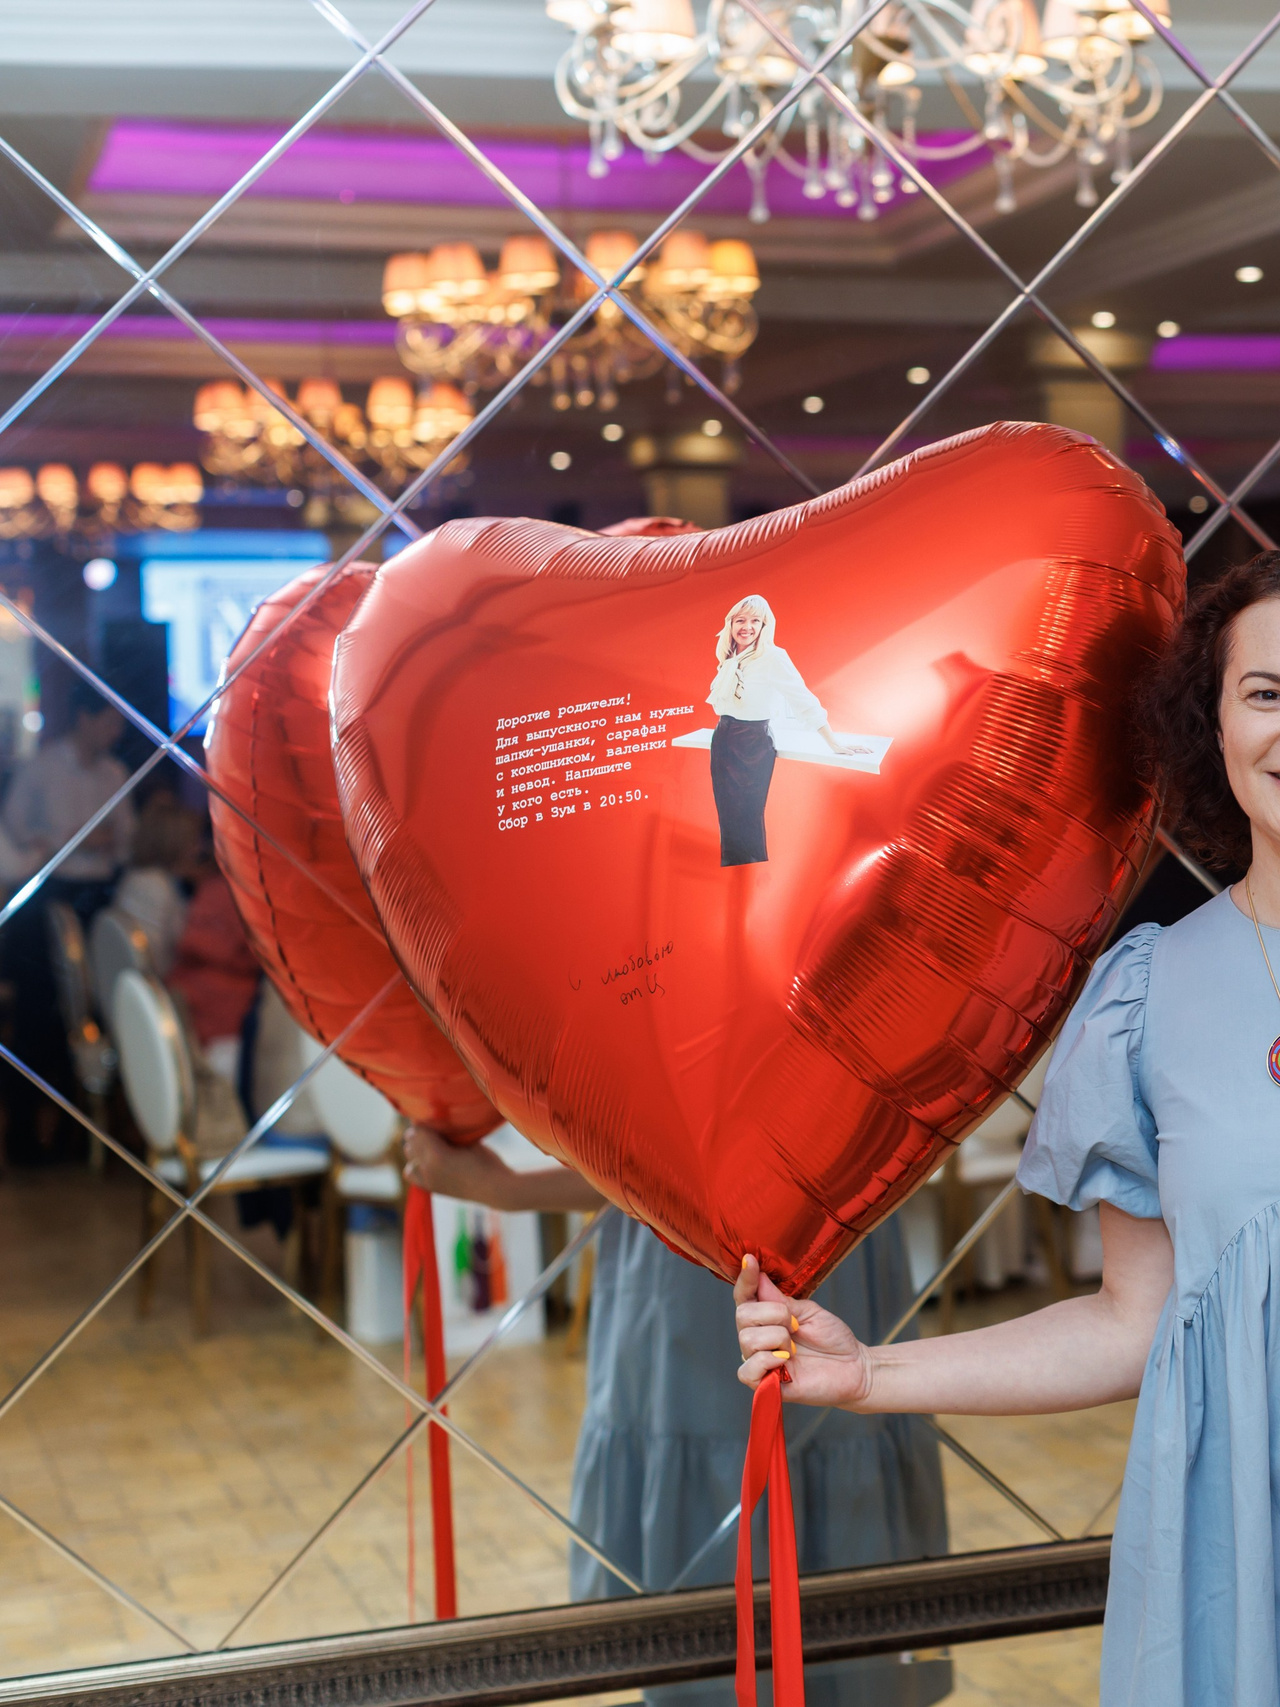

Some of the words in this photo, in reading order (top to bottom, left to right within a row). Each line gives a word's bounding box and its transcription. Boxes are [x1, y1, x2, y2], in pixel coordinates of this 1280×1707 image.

[495, 736, 519, 750] Для
[526, 718, 607, 742] выпускного
[615, 713, 642, 724] нам
[649, 705, 695, 720] нужны
[496, 710, 551, 731] Дорогие
[557, 693, 632, 718] родители!
[495, 736, 596, 765] шапки-ушанки,
[606, 724, 667, 741] сарафан
[496, 771, 504, 781] с
[510, 753, 596, 778] кокошником,
[606, 739, 667, 757] валенки
[496, 788, 505, 798] и
[511, 778, 556, 794] невод.
[565, 761, 632, 781] Напишите
[496, 804, 506, 816] у
[512, 795, 543, 811] кого
[550, 786, 590, 801] есть.
[498, 814, 529, 831] Сбор
[535, 812, 543, 822] в
[551, 804, 576, 818] Зум
[583, 801, 592, 811] в
[600, 789, 649, 808] 20:50.
[620, 987, 643, 1005] от
